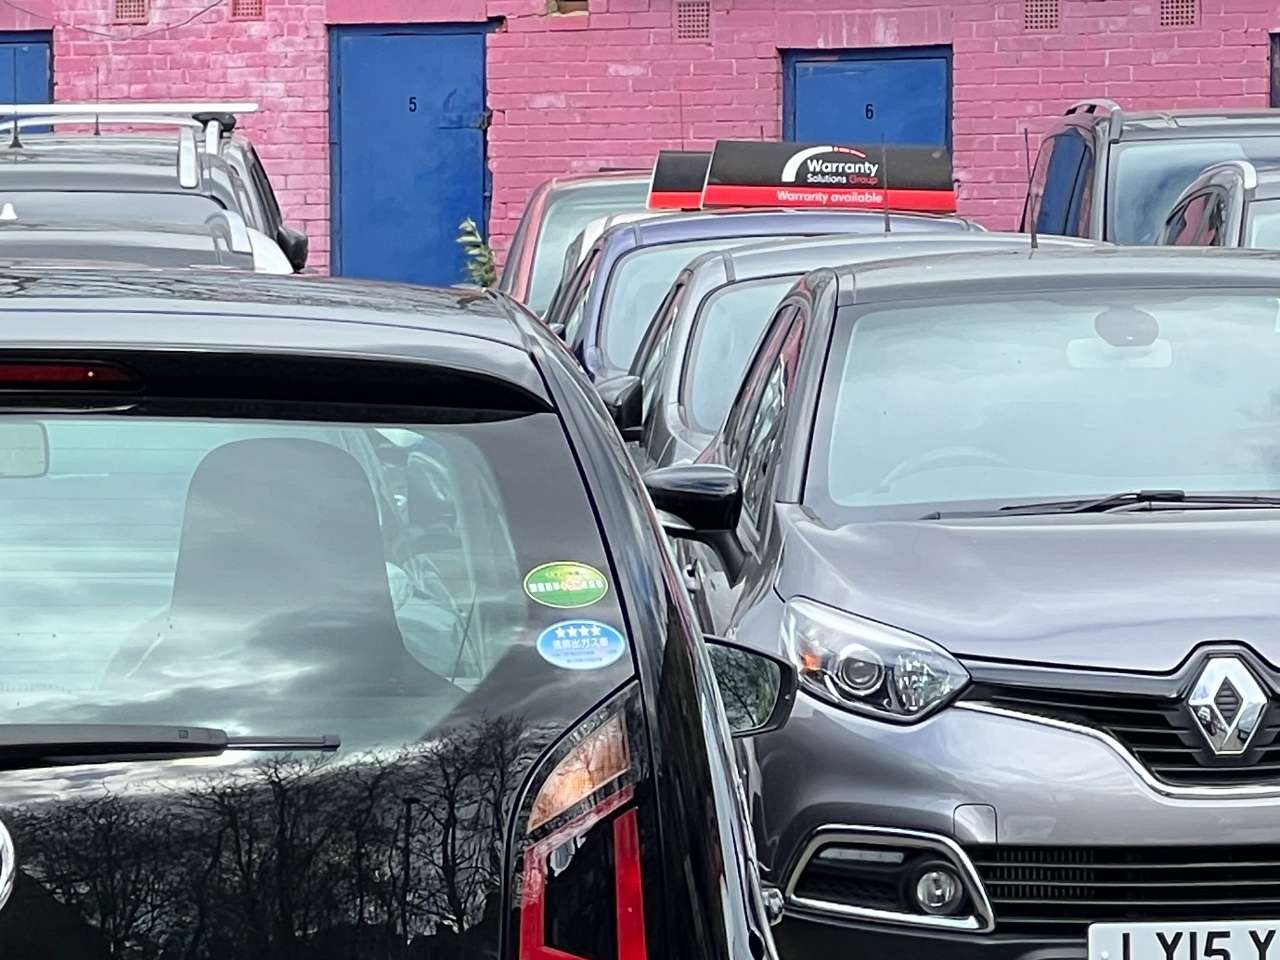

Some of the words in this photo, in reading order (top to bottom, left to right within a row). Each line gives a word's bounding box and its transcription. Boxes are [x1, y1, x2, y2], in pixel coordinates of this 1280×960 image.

[409, 96, 417, 112] 5
[865, 104, 874, 120] 6
[807, 159, 878, 177] Warranty
[806, 174, 847, 184] Solutions
[849, 175, 879, 185] Group
[777, 190, 828, 205] Warranty
[830, 192, 883, 204] available
